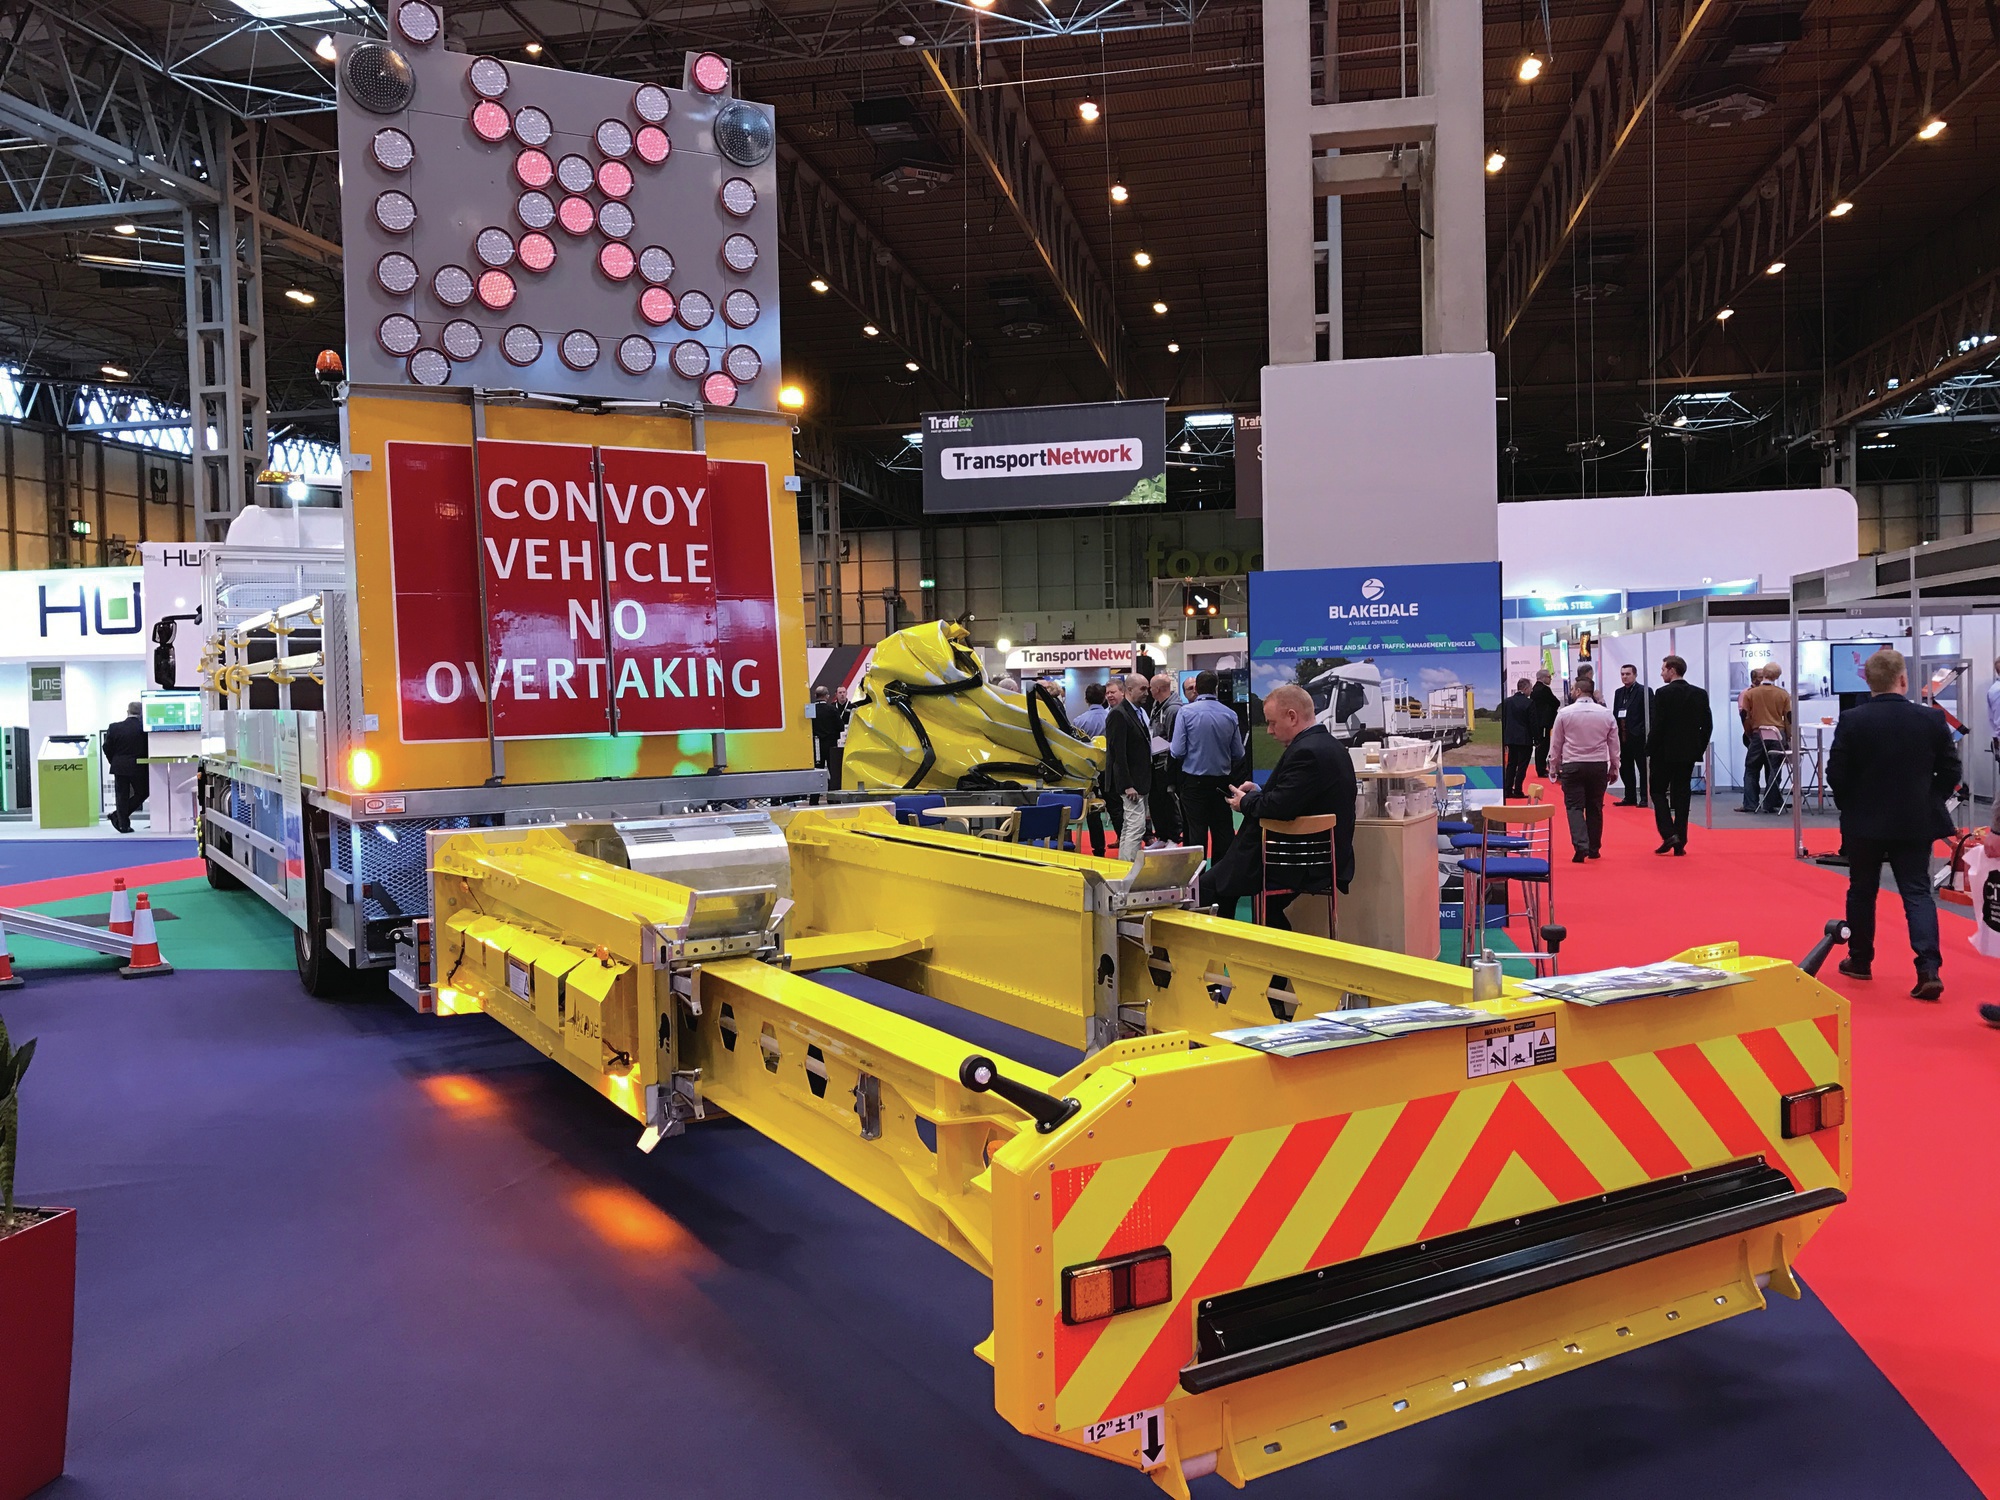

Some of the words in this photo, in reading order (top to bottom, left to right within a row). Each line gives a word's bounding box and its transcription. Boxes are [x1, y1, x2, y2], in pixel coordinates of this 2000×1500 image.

[928, 415, 974, 429] Traffex
[952, 444, 1133, 472] TransportNetwork
[487, 477, 706, 527] CONVOY
[164, 549, 202, 566] HU
[483, 537, 712, 584] VEHICLE
[1329, 602, 1419, 619] BLAKEDALE
[1570, 601, 1595, 610] STEEL
[567, 598, 647, 641] NO
[1406, 641, 1447, 649] MANAGEMENT
[1447, 640, 1476, 648] VEHICLES
[425, 657, 761, 704] OVERTAKING
[53, 764, 83, 772] FAAC
[1485, 1026, 1511, 1036] WARNING
